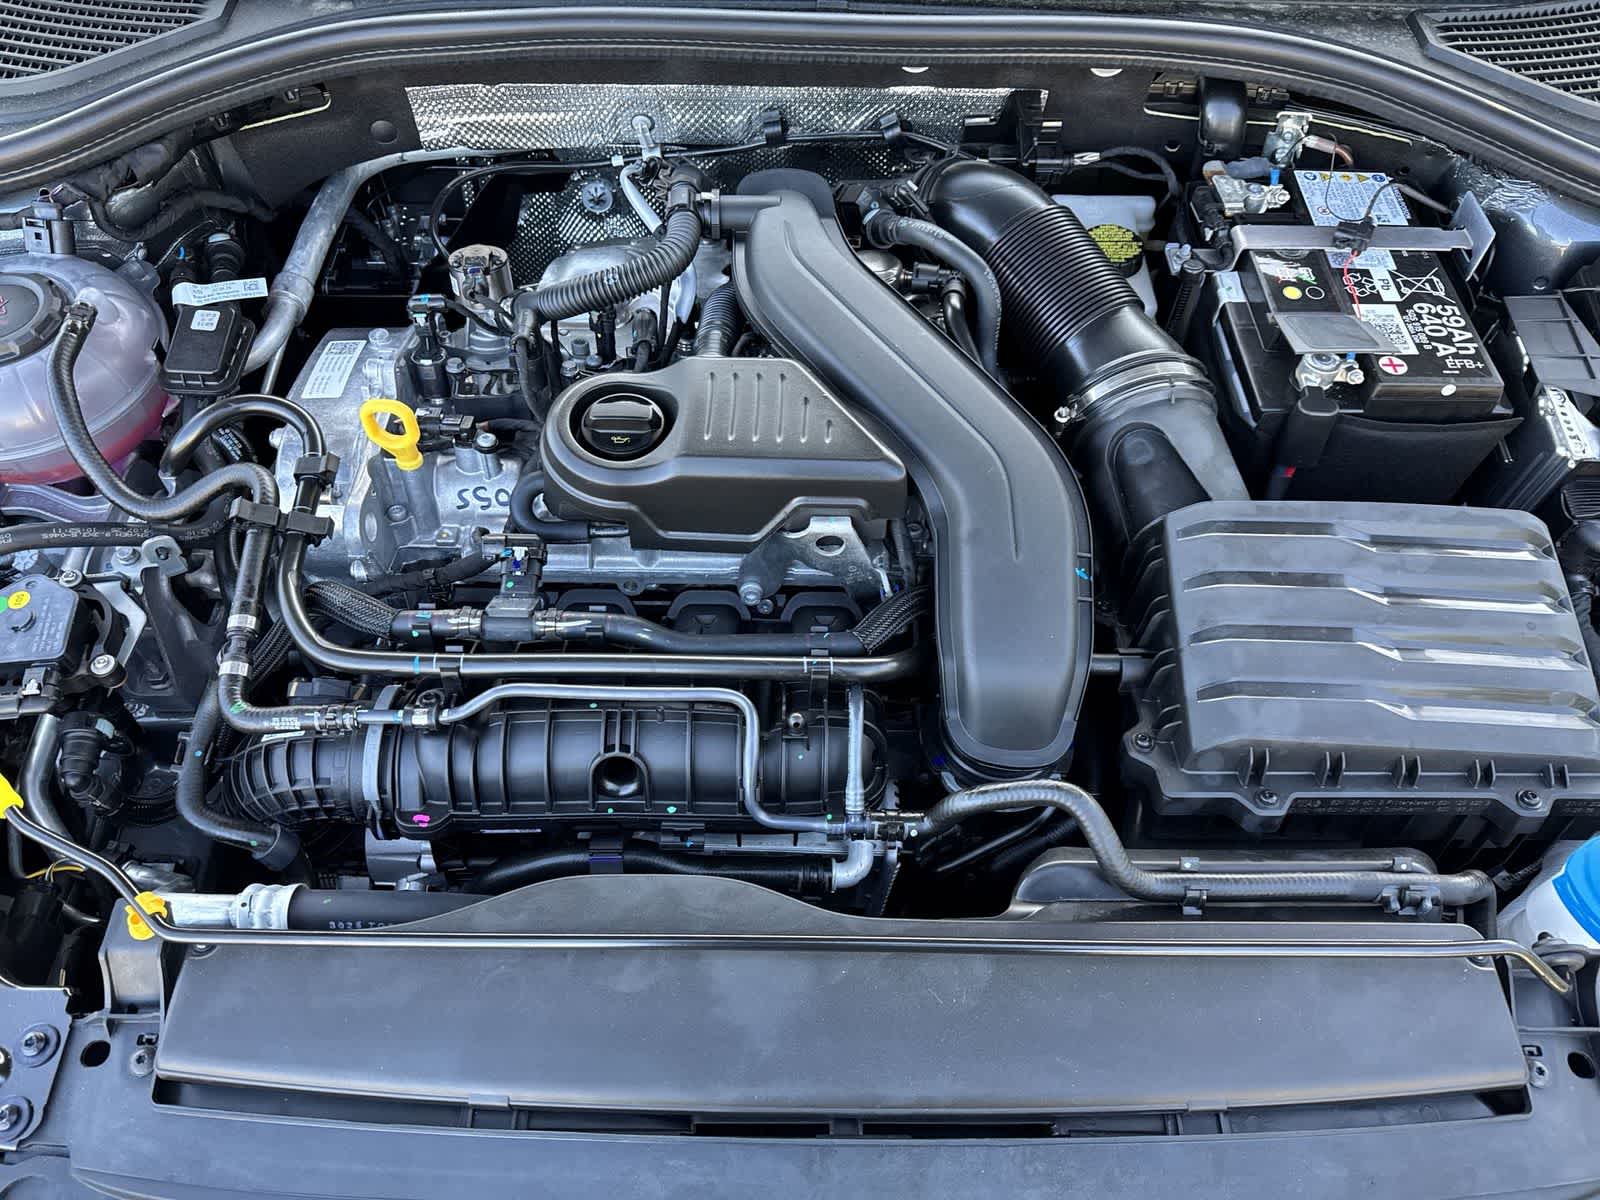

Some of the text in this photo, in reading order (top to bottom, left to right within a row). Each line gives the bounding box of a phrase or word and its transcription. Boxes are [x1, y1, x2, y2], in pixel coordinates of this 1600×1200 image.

[1412, 302, 1458, 357] 640 A
[1436, 304, 1478, 355] 59Ah
